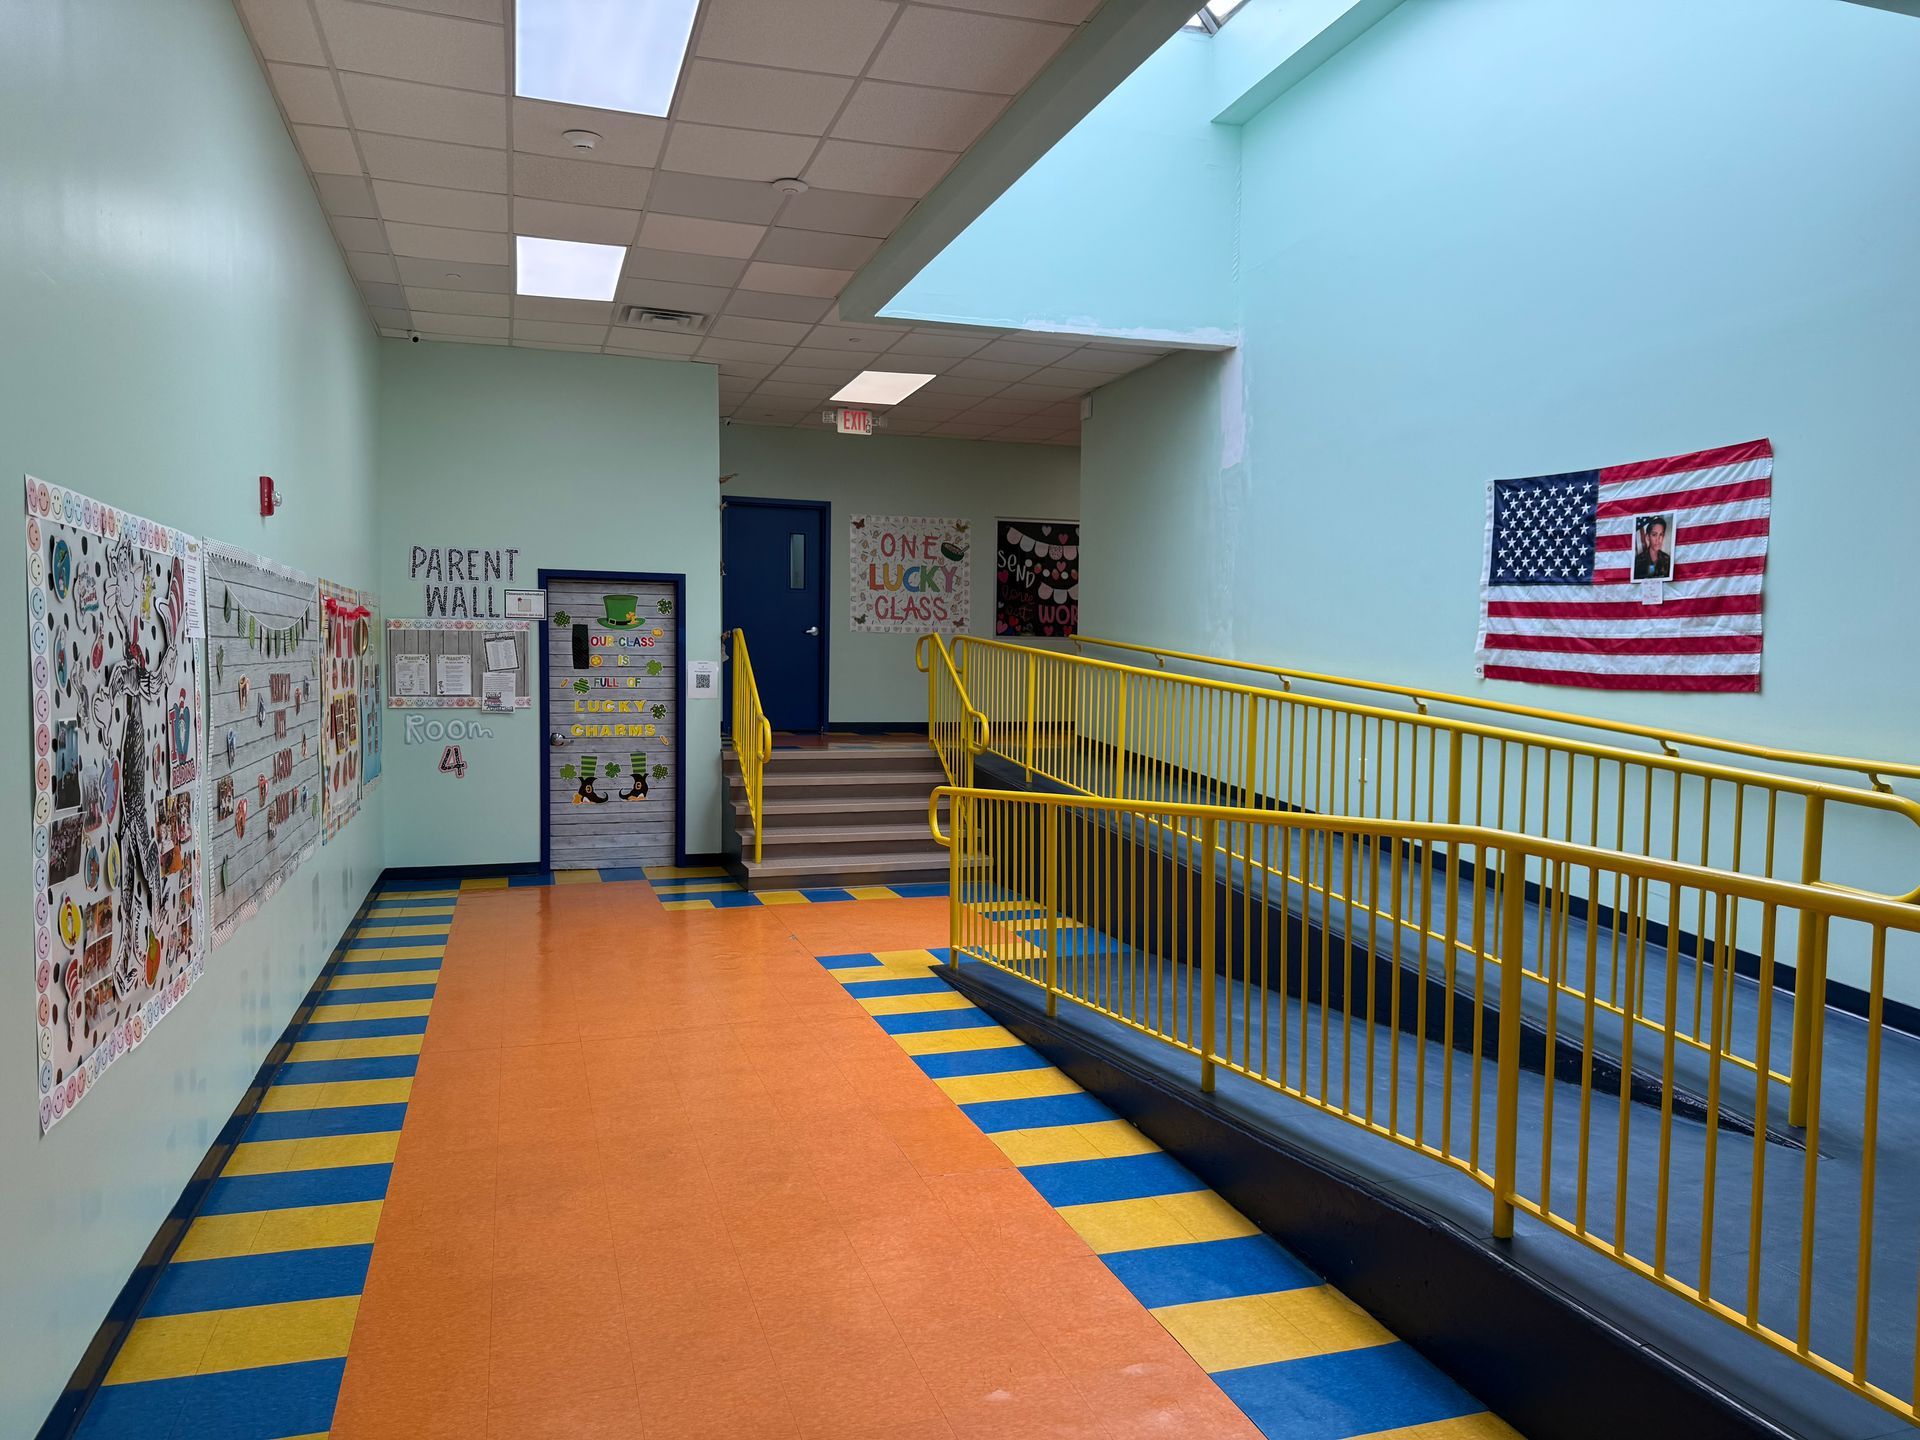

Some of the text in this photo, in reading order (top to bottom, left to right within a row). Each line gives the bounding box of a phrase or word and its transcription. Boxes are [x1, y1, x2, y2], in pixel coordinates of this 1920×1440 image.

[844, 411, 867, 431] EXIT
[881, 533, 939, 560] ONE
[411, 545, 519, 581] PARENT
[869, 562, 958, 593] LUCKY
[426, 584, 500, 618] WALL
[875, 595, 948, 622] CLASS
[590, 635, 655, 648] OUR CLASS
[617, 655, 630, 667] IS
[594, 678, 641, 688] FULL OF
[575, 700, 647, 713] LUCKY
[571, 724, 656, 737] CHARMS
[439, 746, 467, 777] 4
